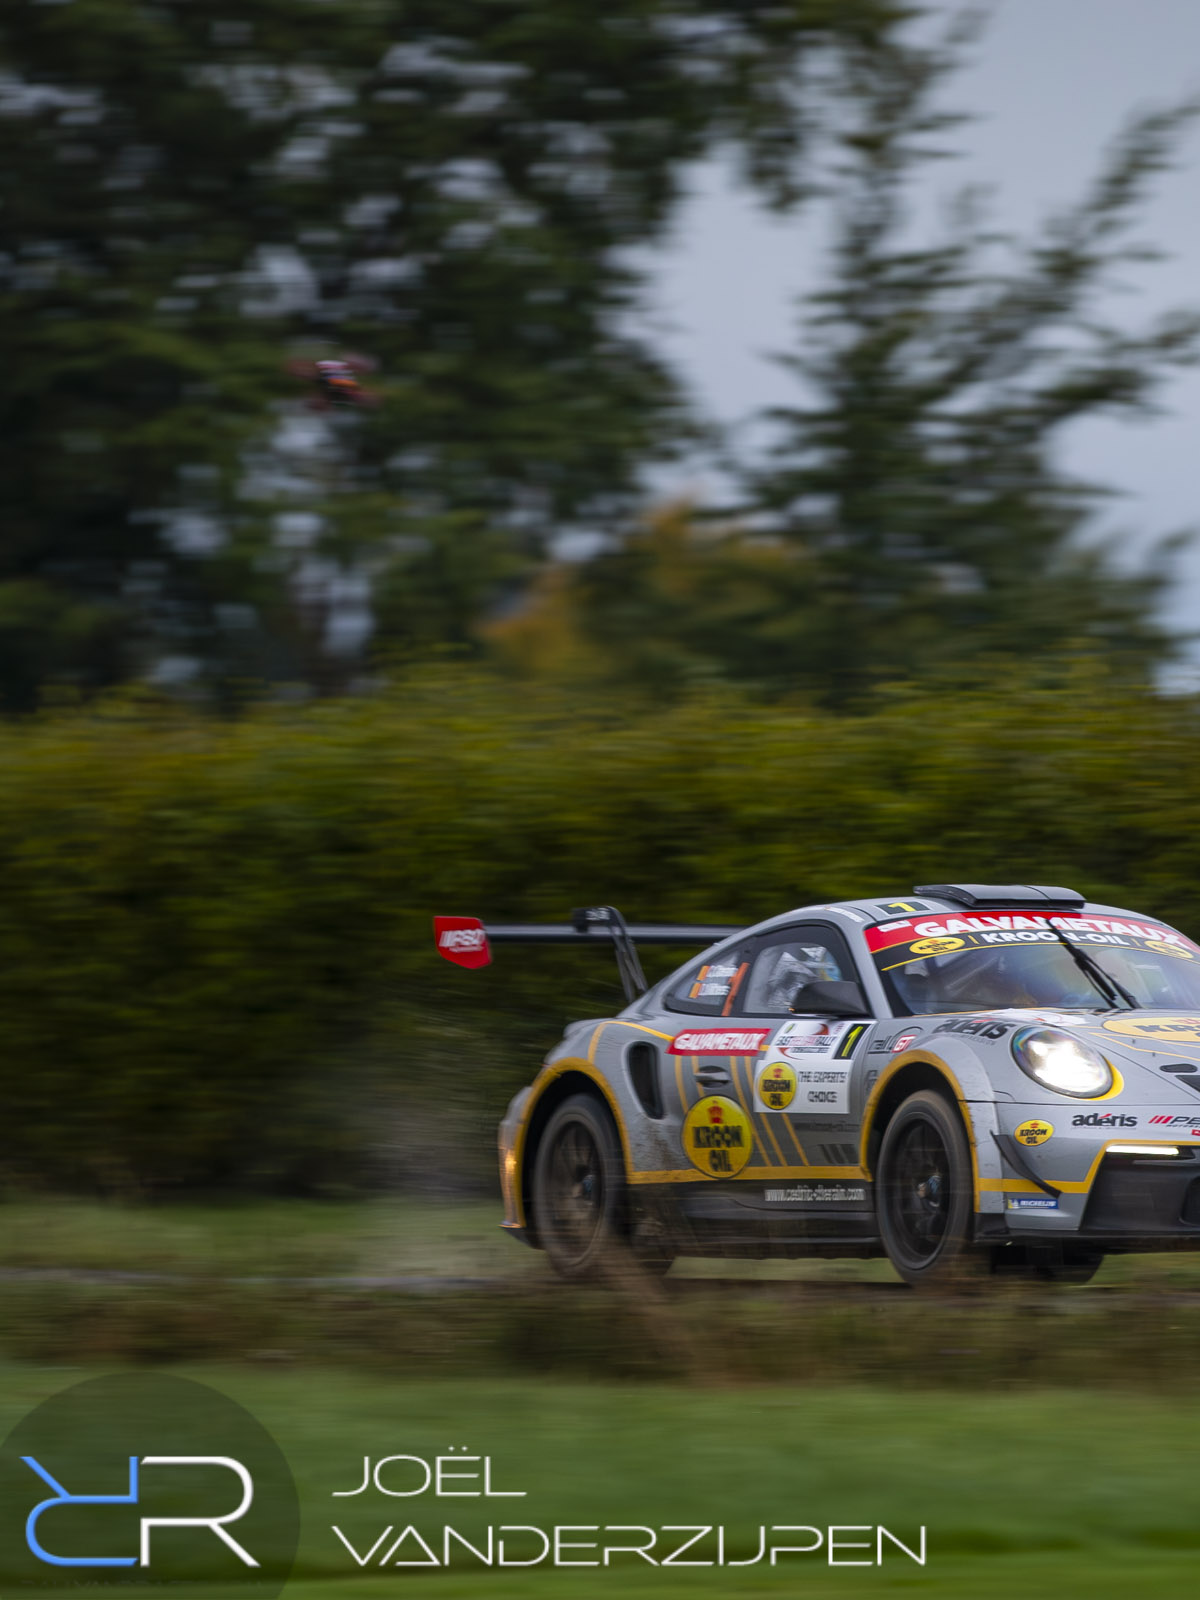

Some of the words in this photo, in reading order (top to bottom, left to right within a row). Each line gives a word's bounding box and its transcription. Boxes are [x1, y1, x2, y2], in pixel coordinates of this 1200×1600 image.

[914, 915, 1191, 950] GALVAMETAUX
[980, 931, 1130, 946] KROON-OIL
[674, 1032, 766, 1051] GALVAMETAUX
[841, 1025, 864, 1057] 1
[1072, 1113, 1138, 1127] adéris
[692, 1125, 744, 1148] KROON
[1019, 1128, 1047, 1137] KROON
[1025, 1136, 1038, 1144] OIL
[709, 1150, 734, 1171] OIL
